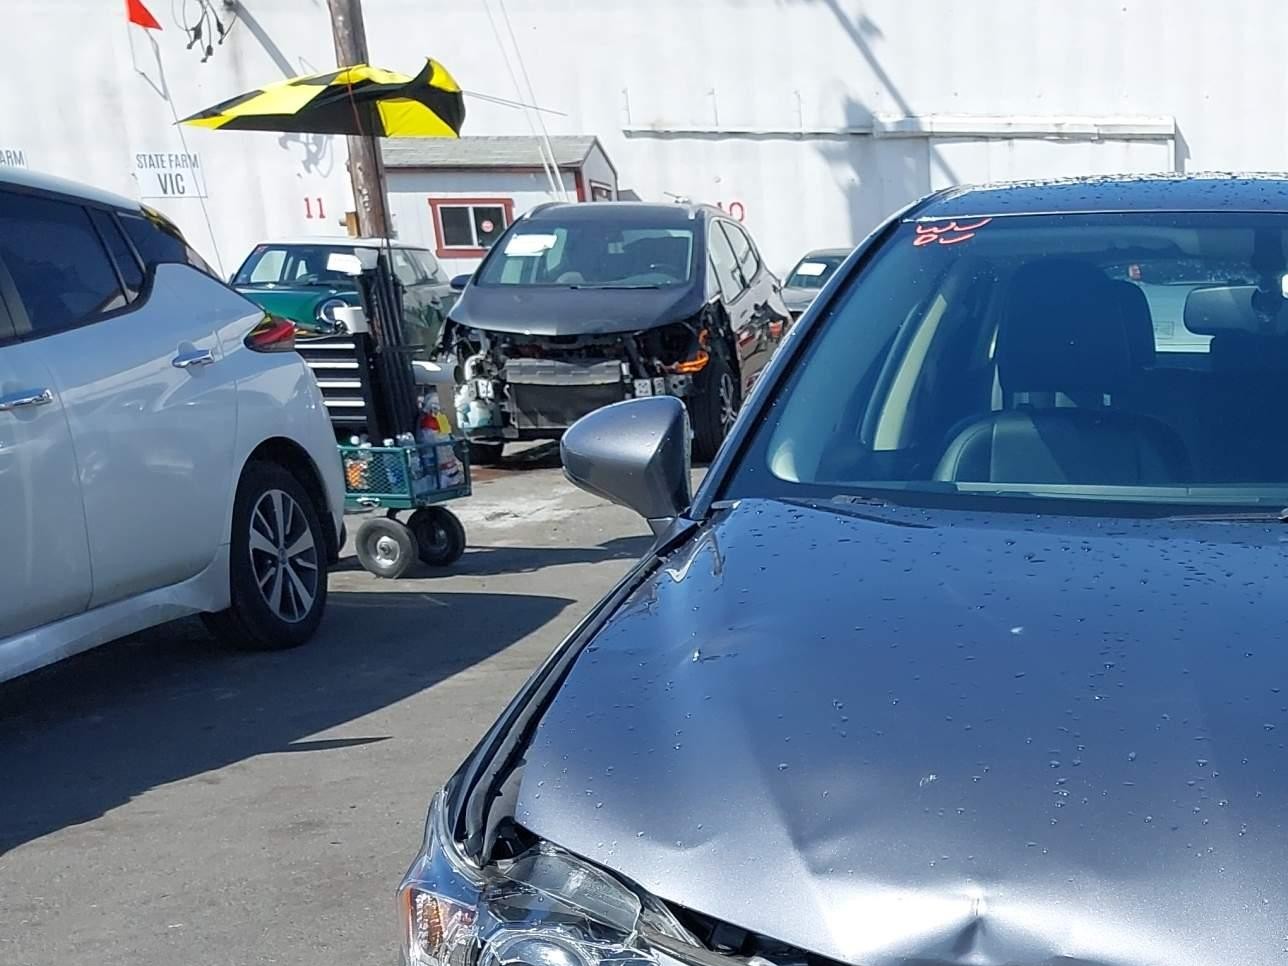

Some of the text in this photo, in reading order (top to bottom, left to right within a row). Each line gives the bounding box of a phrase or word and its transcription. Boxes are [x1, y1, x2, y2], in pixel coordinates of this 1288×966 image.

[135, 153, 199, 169] STATE FARM
[157, 173, 185, 195] VIC
[304, 197, 326, 219] 11
